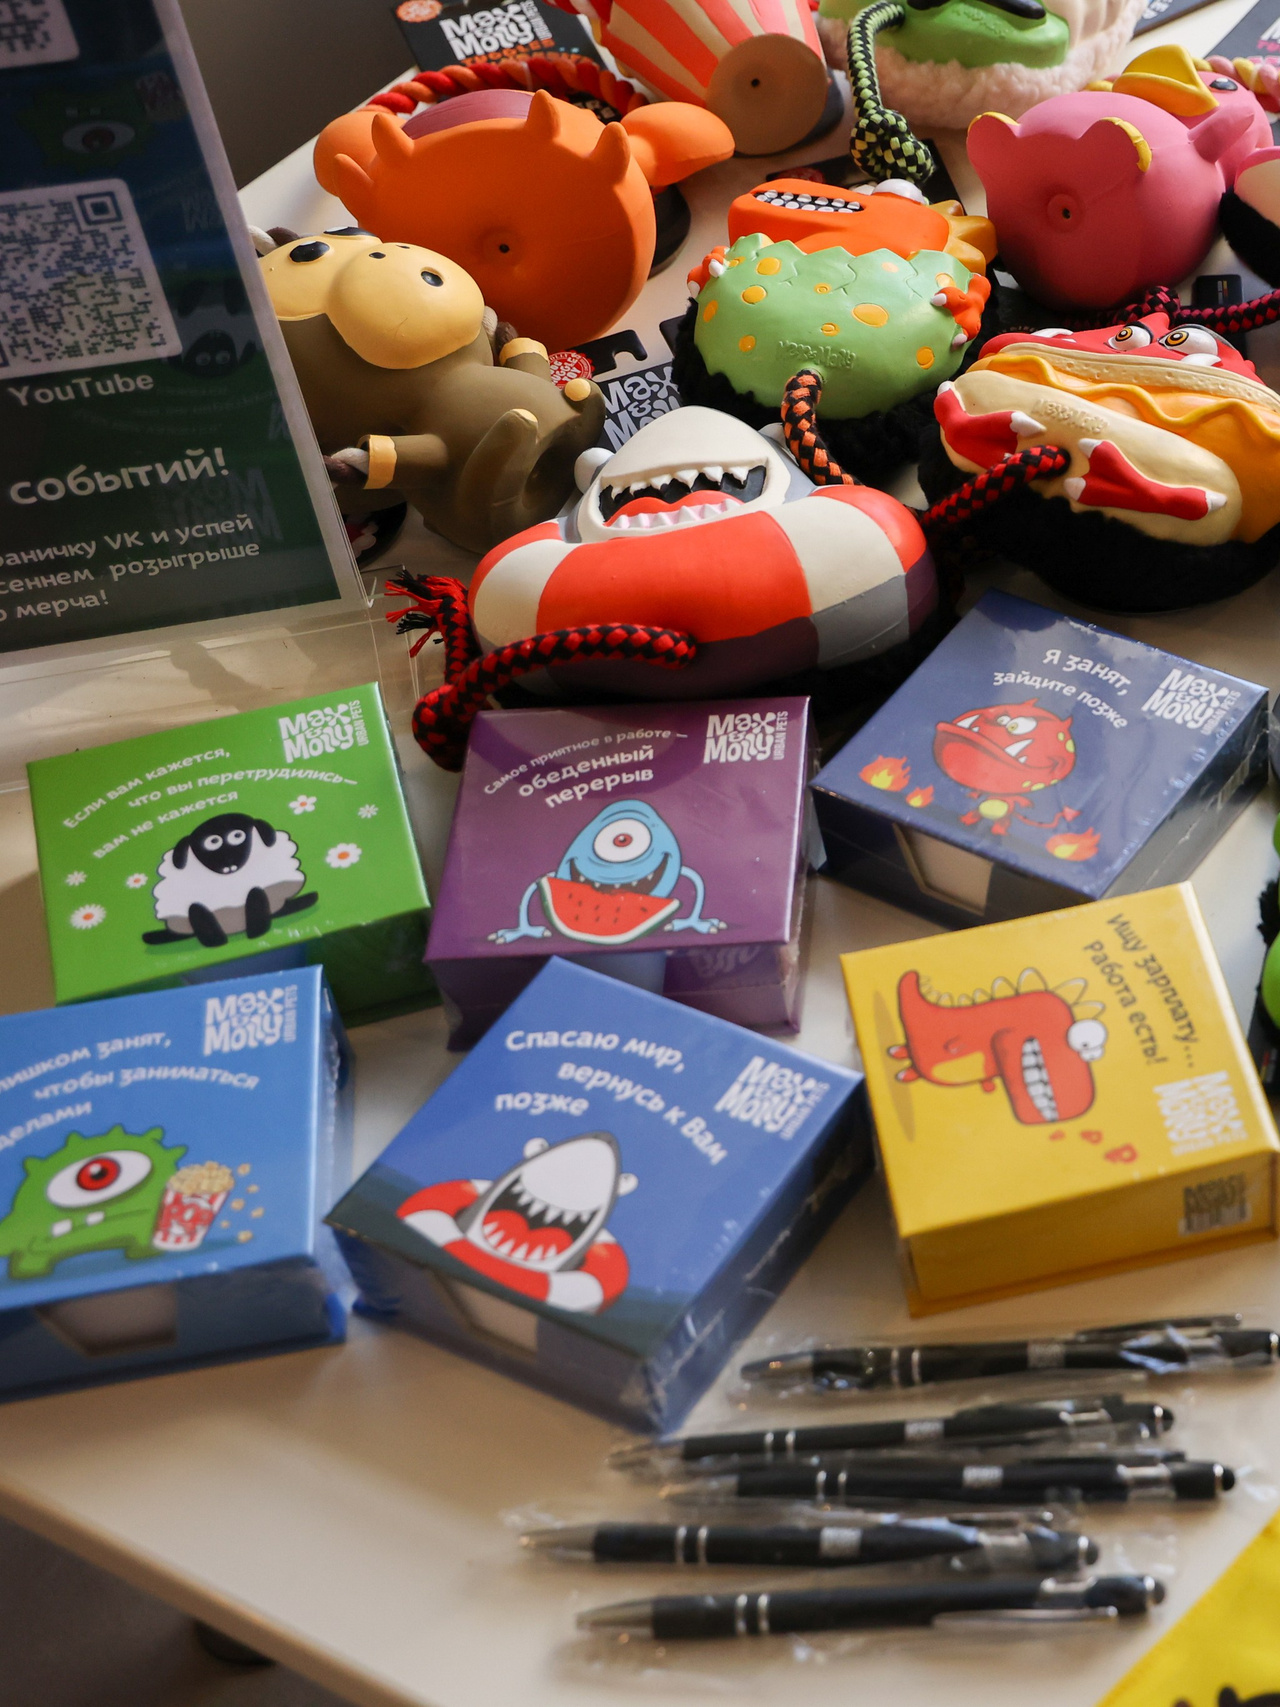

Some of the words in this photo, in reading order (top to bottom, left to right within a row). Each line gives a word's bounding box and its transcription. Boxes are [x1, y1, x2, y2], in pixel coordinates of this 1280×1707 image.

[439, 4, 527, 41] Max
[448, 20, 535, 61] Molly
[8, 374, 154, 406] YouTube
[602, 366, 682, 415] Max
[9, 447, 229, 504] событий!
[104, 531, 144, 550] VK
[151, 530, 169, 544] и
[175, 513, 254, 545] успей
[109, 542, 260, 581] розыгрыше
[17, 589, 109, 617] мерча!
[1042, 648, 1062, 666] Я
[1062, 655, 1132, 697] занят,
[1158, 667, 1231, 709] Max
[348, 699, 363, 721] PETS
[992, 669, 1077, 698] зайдите
[1077, 689, 1130, 730] позже
[1140, 688, 1216, 731] Molly
[278, 703, 353, 741] Max
[352, 718, 370, 748] URBAN
[705, 711, 778, 739] Max
[775, 710, 789, 733] PETS
[281, 723, 355, 764] Molly
[484, 764, 529, 796] Самое
[530, 737, 600, 768] приятное
[603, 733, 614, 744] в
[616, 728, 672, 744] работе
[702, 732, 776, 765] Molly
[771, 734, 787, 761] URBAN
[63, 797, 107, 829] Если
[106, 777, 143, 801] вам
[145, 747, 231, 781] кажется,
[518, 744, 655, 798] обеденный
[544, 768, 655, 809] перерыв
[128, 789, 162, 808] что
[166, 780, 194, 797] вы
[93, 834, 130, 860] вам
[130, 819, 154, 837] не
[156, 790, 240, 825] кажется
[1106, 913, 1147, 953] Ищу
[205, 987, 285, 1026] Max
[1084, 939, 1138, 1009] Работа
[1128, 1010, 1169, 1065] есть!
[97, 1032, 172, 1060] занят,
[203, 1013, 284, 1057] Molly
[505, 1029, 621, 1052] Спасаю
[622, 1036, 686, 1074] мир,
[33, 1070, 114, 1101] чтобы
[119, 1065, 261, 1091] заниматься
[736, 1055, 816, 1105] Max
[494, 1090, 590, 1117] позже
[556, 1061, 666, 1113] вернусь
[662, 1104, 687, 1126] к
[680, 1115, 729, 1167] Вам
[713, 1084, 797, 1134] Molly
